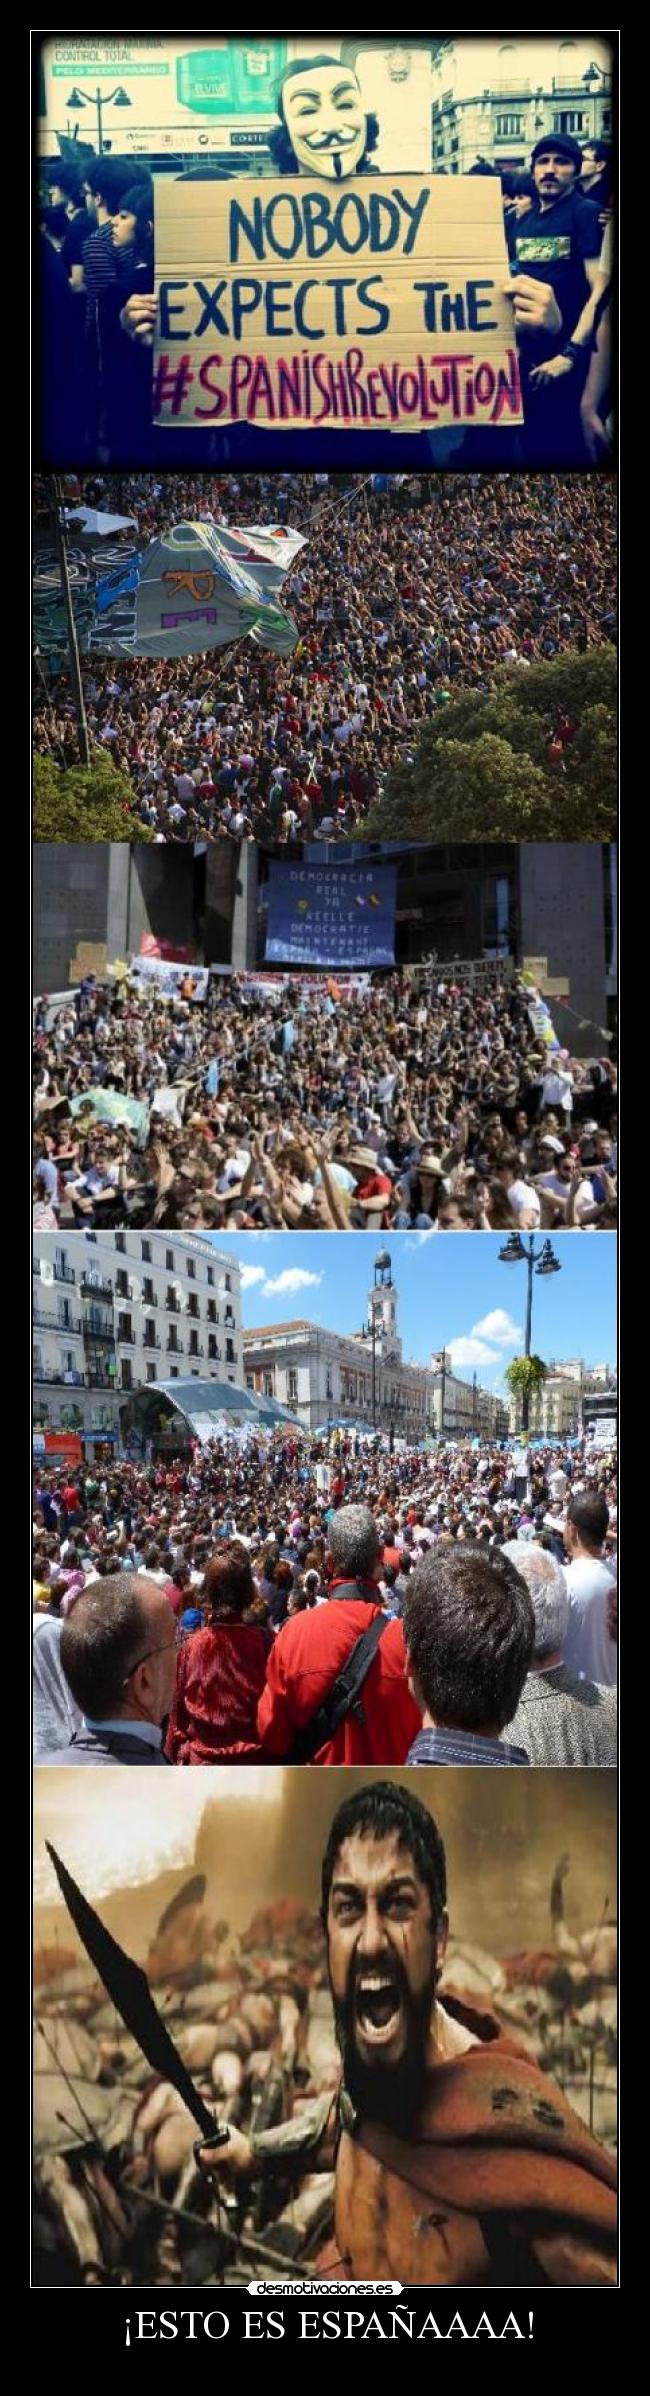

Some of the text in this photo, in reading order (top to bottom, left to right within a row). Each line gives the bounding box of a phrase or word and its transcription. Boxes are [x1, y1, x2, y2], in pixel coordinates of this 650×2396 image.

[55, 50, 102, 61] CONTROL
[229, 188, 431, 263] NOBODY
[159, 275, 498, 341] EXPECTS THE
[316, 886, 347, 896] REAL
